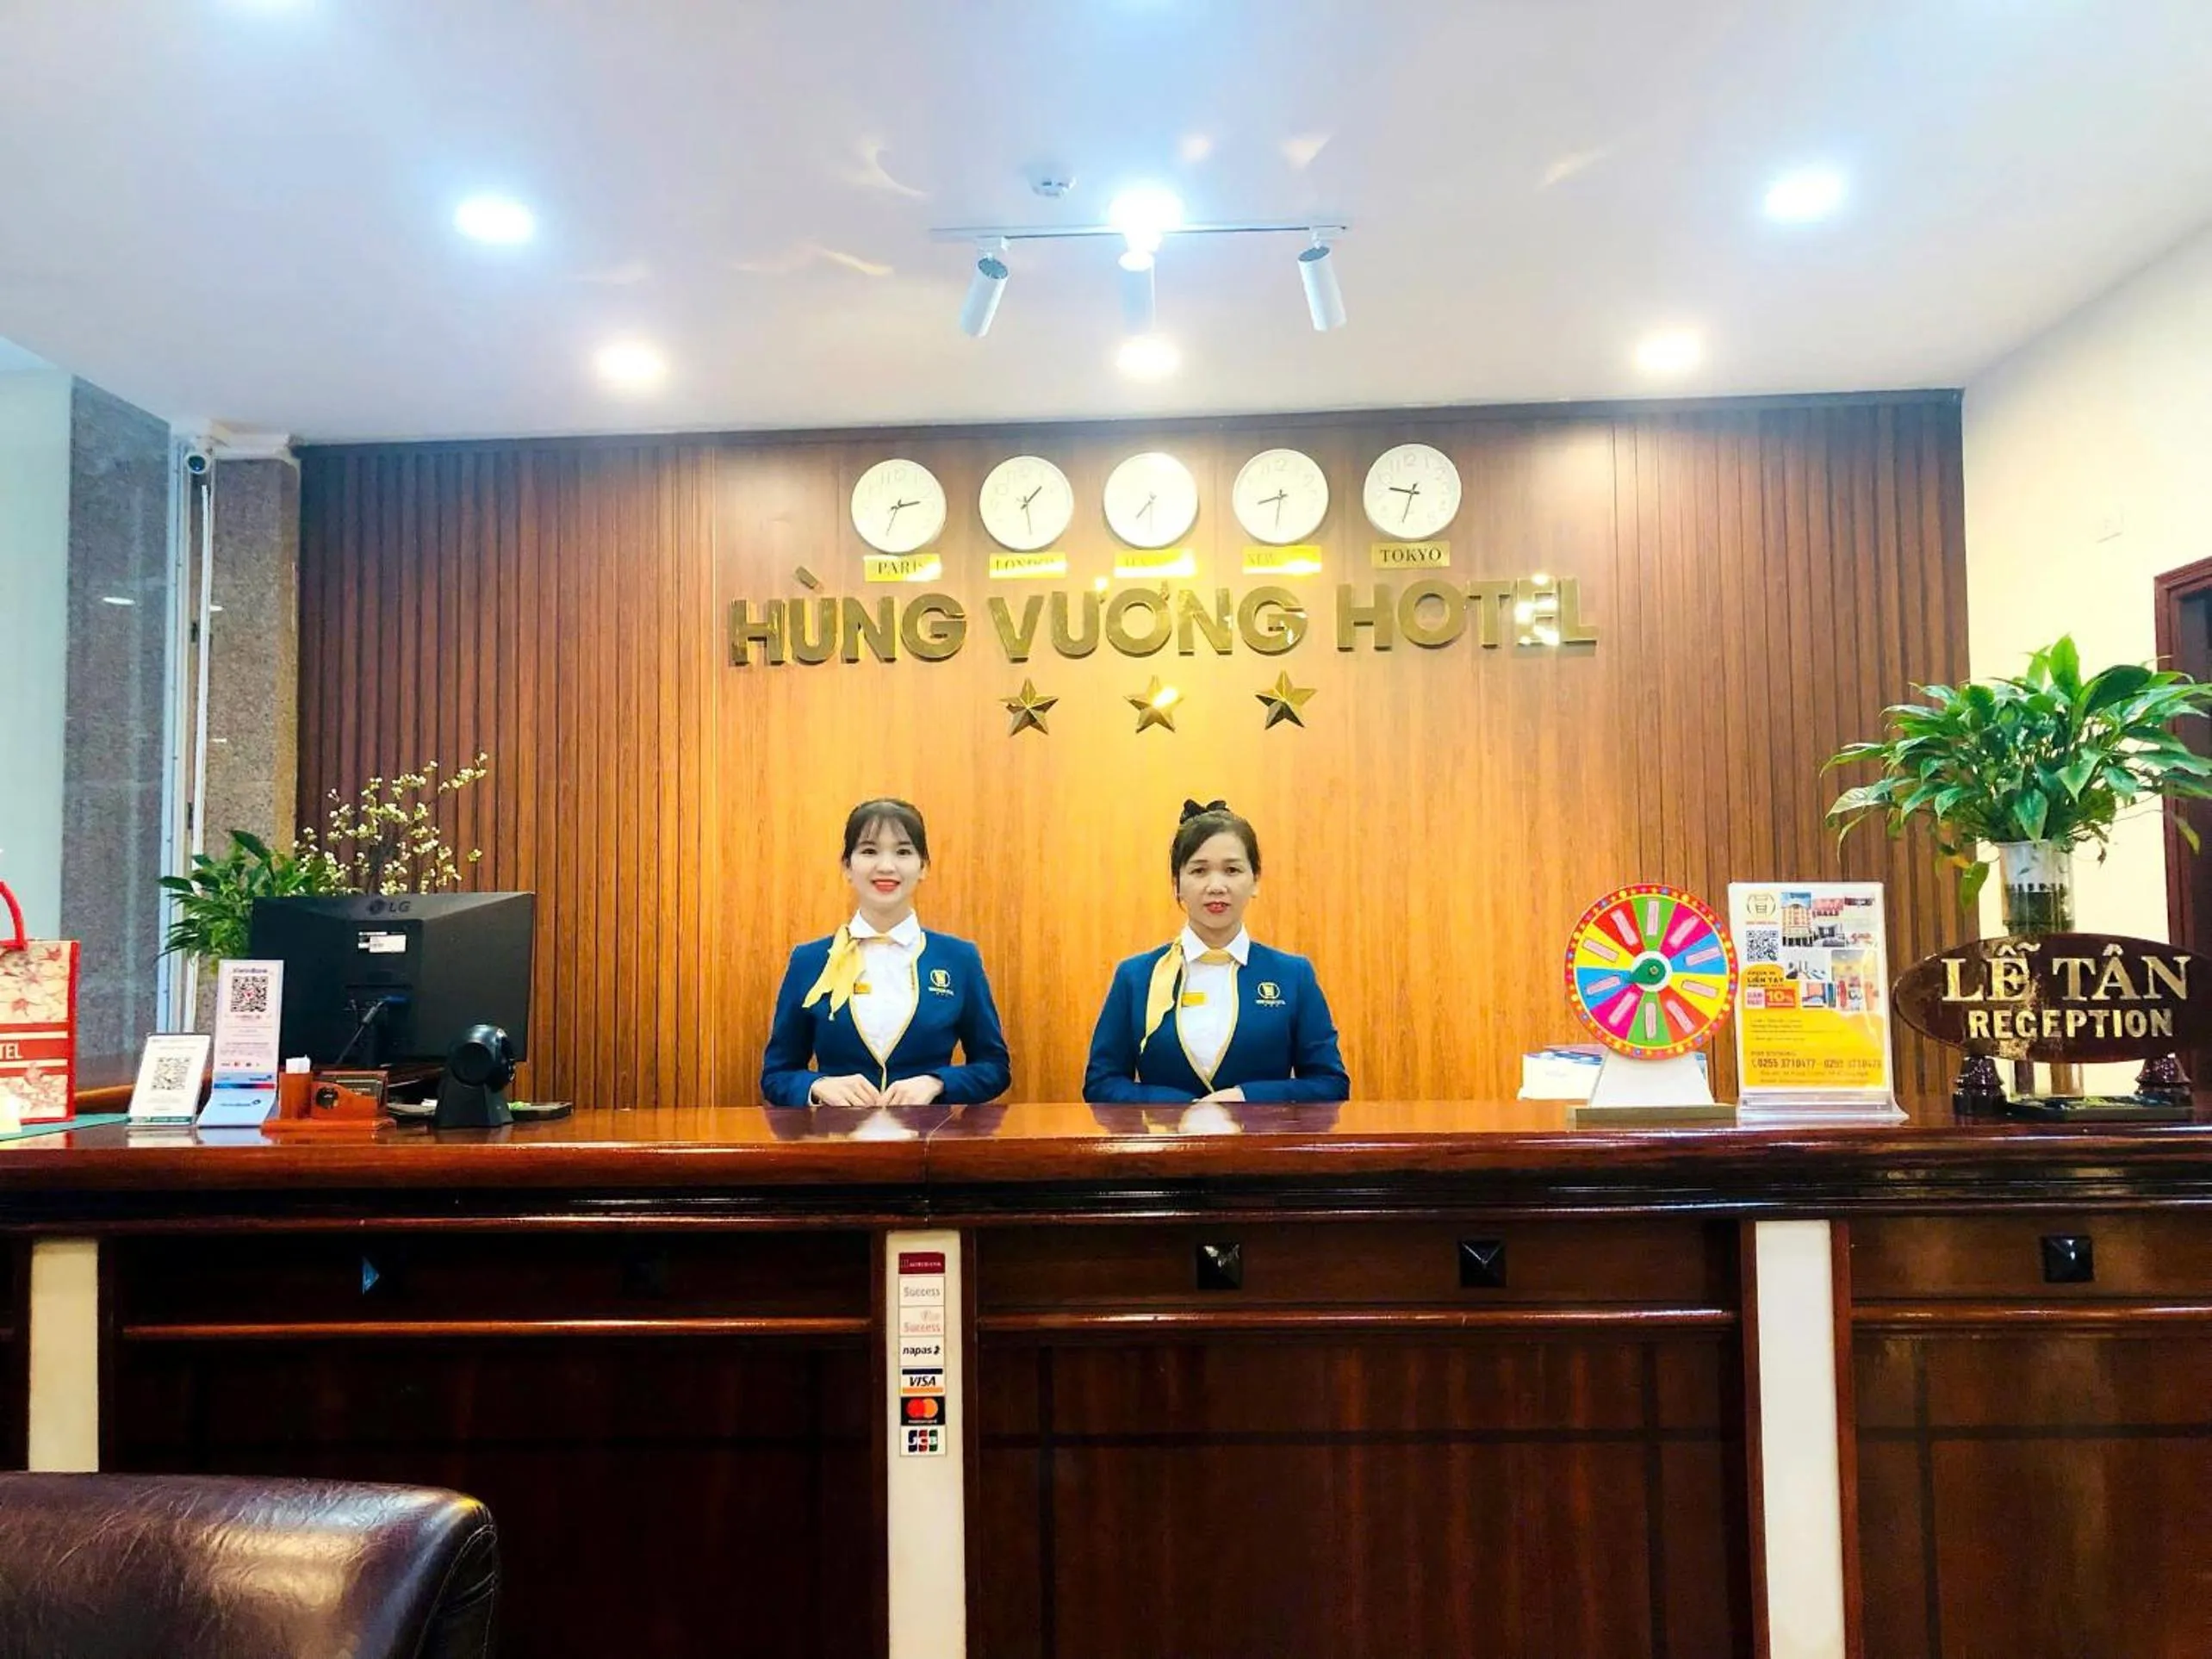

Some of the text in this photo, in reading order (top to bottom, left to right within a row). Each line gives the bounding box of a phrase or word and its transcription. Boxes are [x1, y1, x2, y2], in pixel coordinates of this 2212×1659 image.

[1380, 548, 1442, 563] TOKYO
[730, 565, 1599, 666] HÙNG VƯƠNG HOTEL
[389, 901, 411, 912] LG
[1941, 942, 2191, 1003] LỄ TÂN
[1968, 1008, 2174, 1040] RECEPTION
[904, 1286, 941, 1297] Success
[903, 1346, 932, 1357] napas
[910, 1376, 936, 1387] VISA
